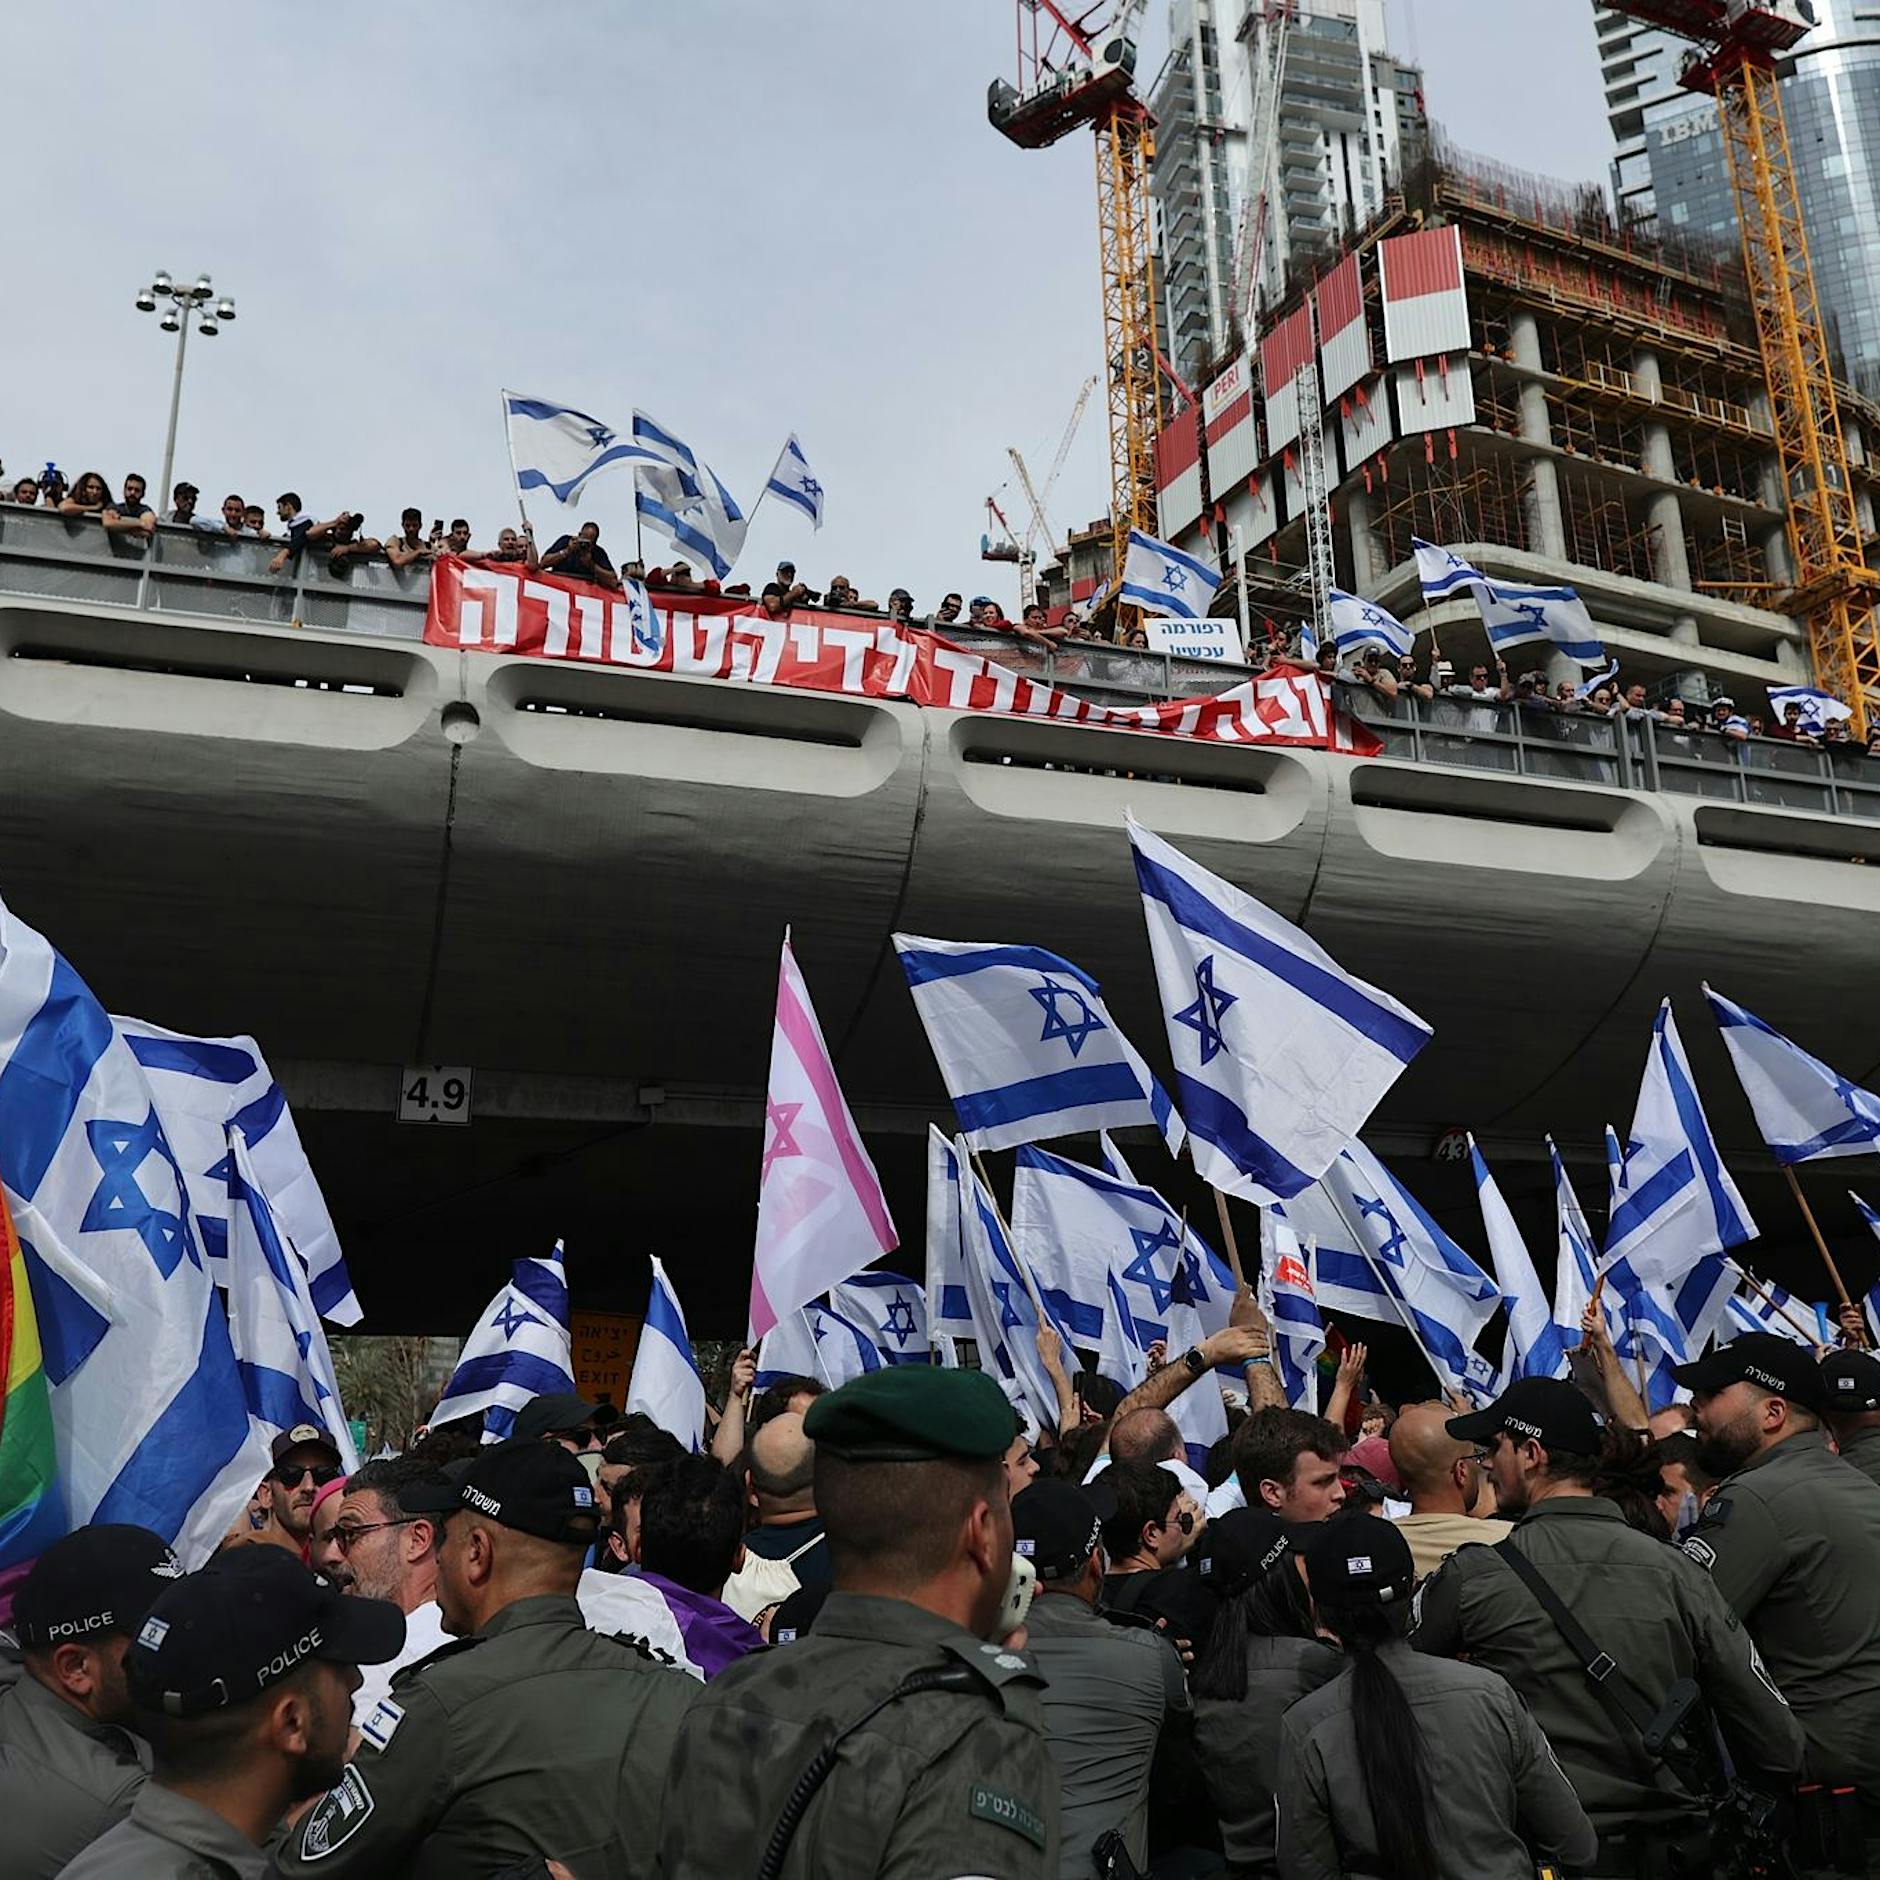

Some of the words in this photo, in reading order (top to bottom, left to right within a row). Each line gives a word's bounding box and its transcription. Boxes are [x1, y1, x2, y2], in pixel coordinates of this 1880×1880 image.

[1659, 112, 1719, 146] IBM
[1137, 350, 1148, 369] 2
[1214, 365, 1239, 399] PERI
[1160, 623, 1224, 634] רפורמה
[407, 1077, 465, 1110] 4.9
[580, 1370, 620, 1384] EXIT
[1744, 1364, 1787, 1391] משטרה
[1504, 1414, 1542, 1438] משטרה
[462, 1485, 501, 1516] משטרה
[1260, 1535, 1288, 1570] POLICE
[48, 1610, 115, 1641] POLICE
[256, 1627, 324, 1687] POLICE
